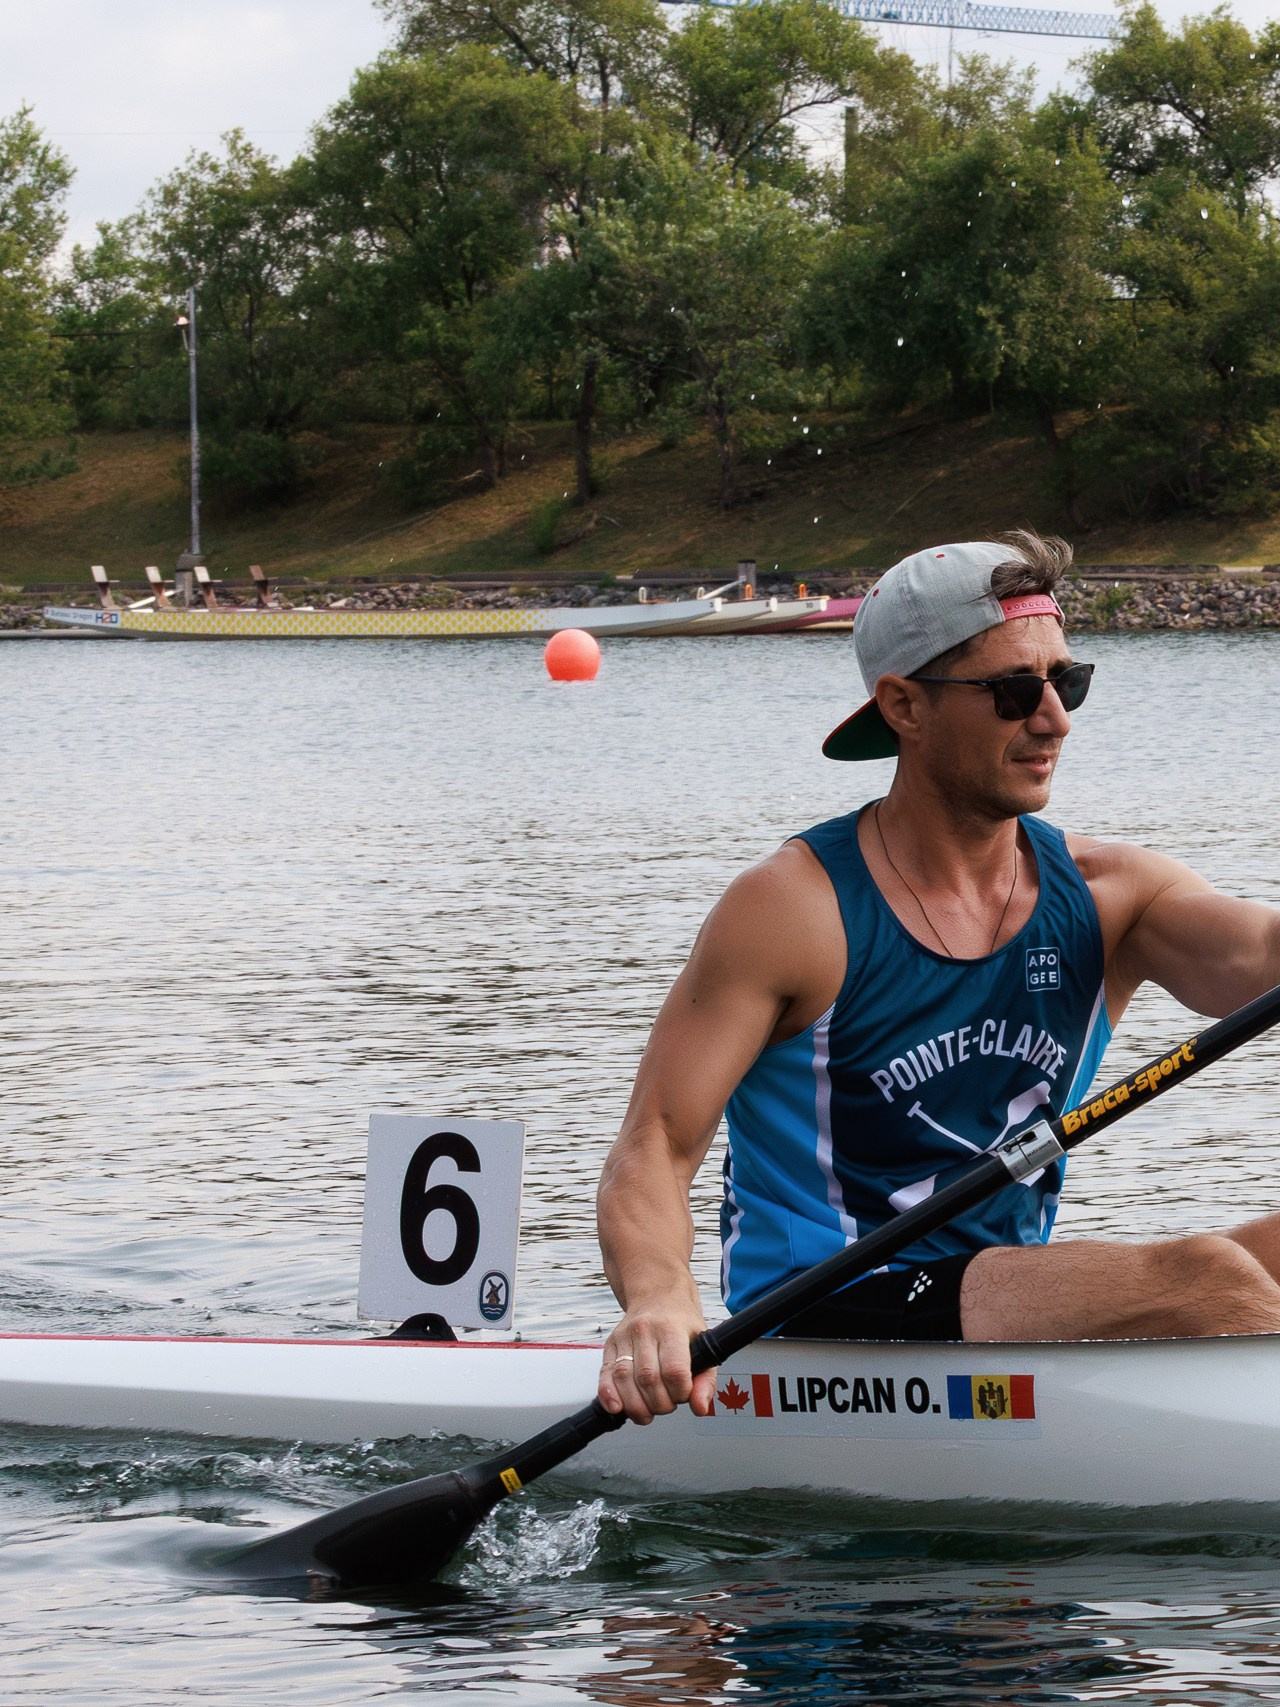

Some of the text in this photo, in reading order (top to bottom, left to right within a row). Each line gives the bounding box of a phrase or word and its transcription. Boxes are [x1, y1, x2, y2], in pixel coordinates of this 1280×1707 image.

[1029, 954, 1057, 967] APO
[1030, 972, 1057, 985] GEE
[870, 1019, 1067, 1103] POINTE-CLAIRE
[400, 1132, 481, 1286] 6
[778, 1376, 942, 1414] LIPCAN O.
